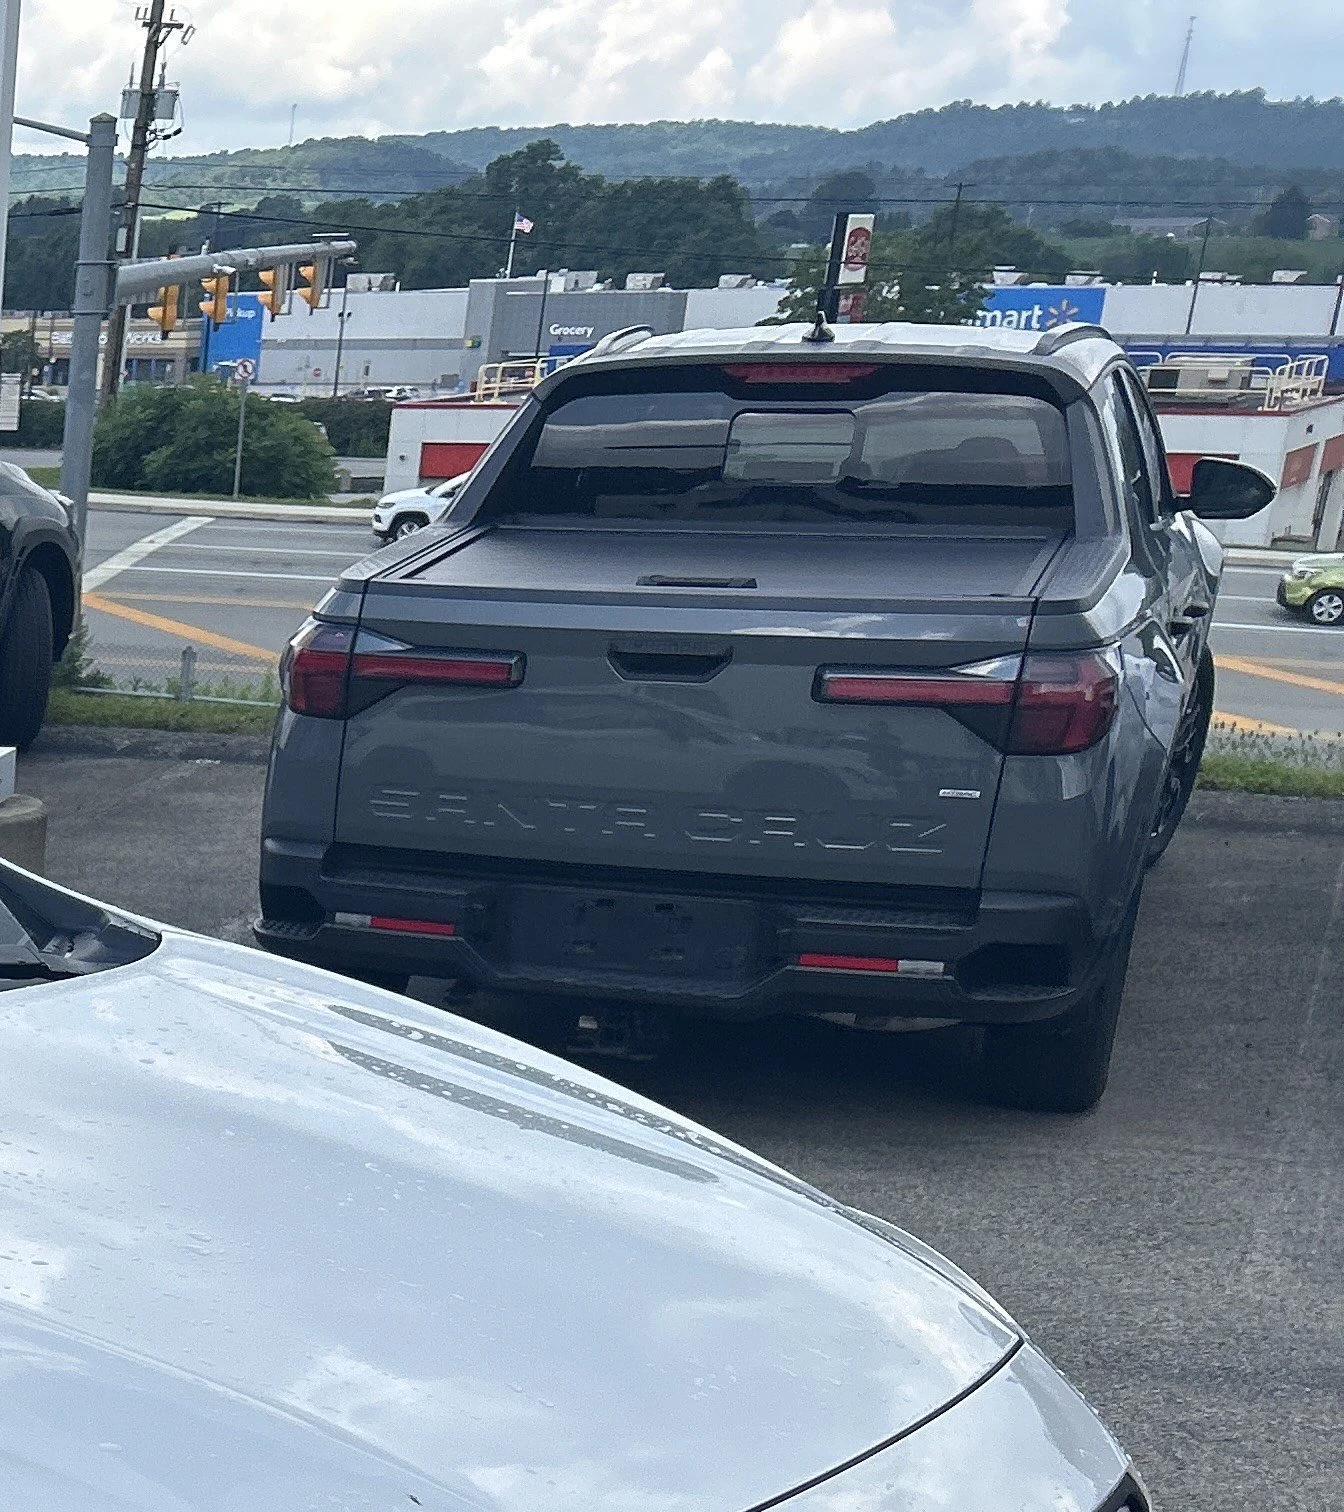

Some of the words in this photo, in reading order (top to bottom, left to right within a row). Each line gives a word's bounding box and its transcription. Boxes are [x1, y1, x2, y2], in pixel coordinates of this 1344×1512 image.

[549, 323, 595, 338] Grocery
[369, 786, 656, 839] SANTA
[684, 806, 948, 854] CRUZ
